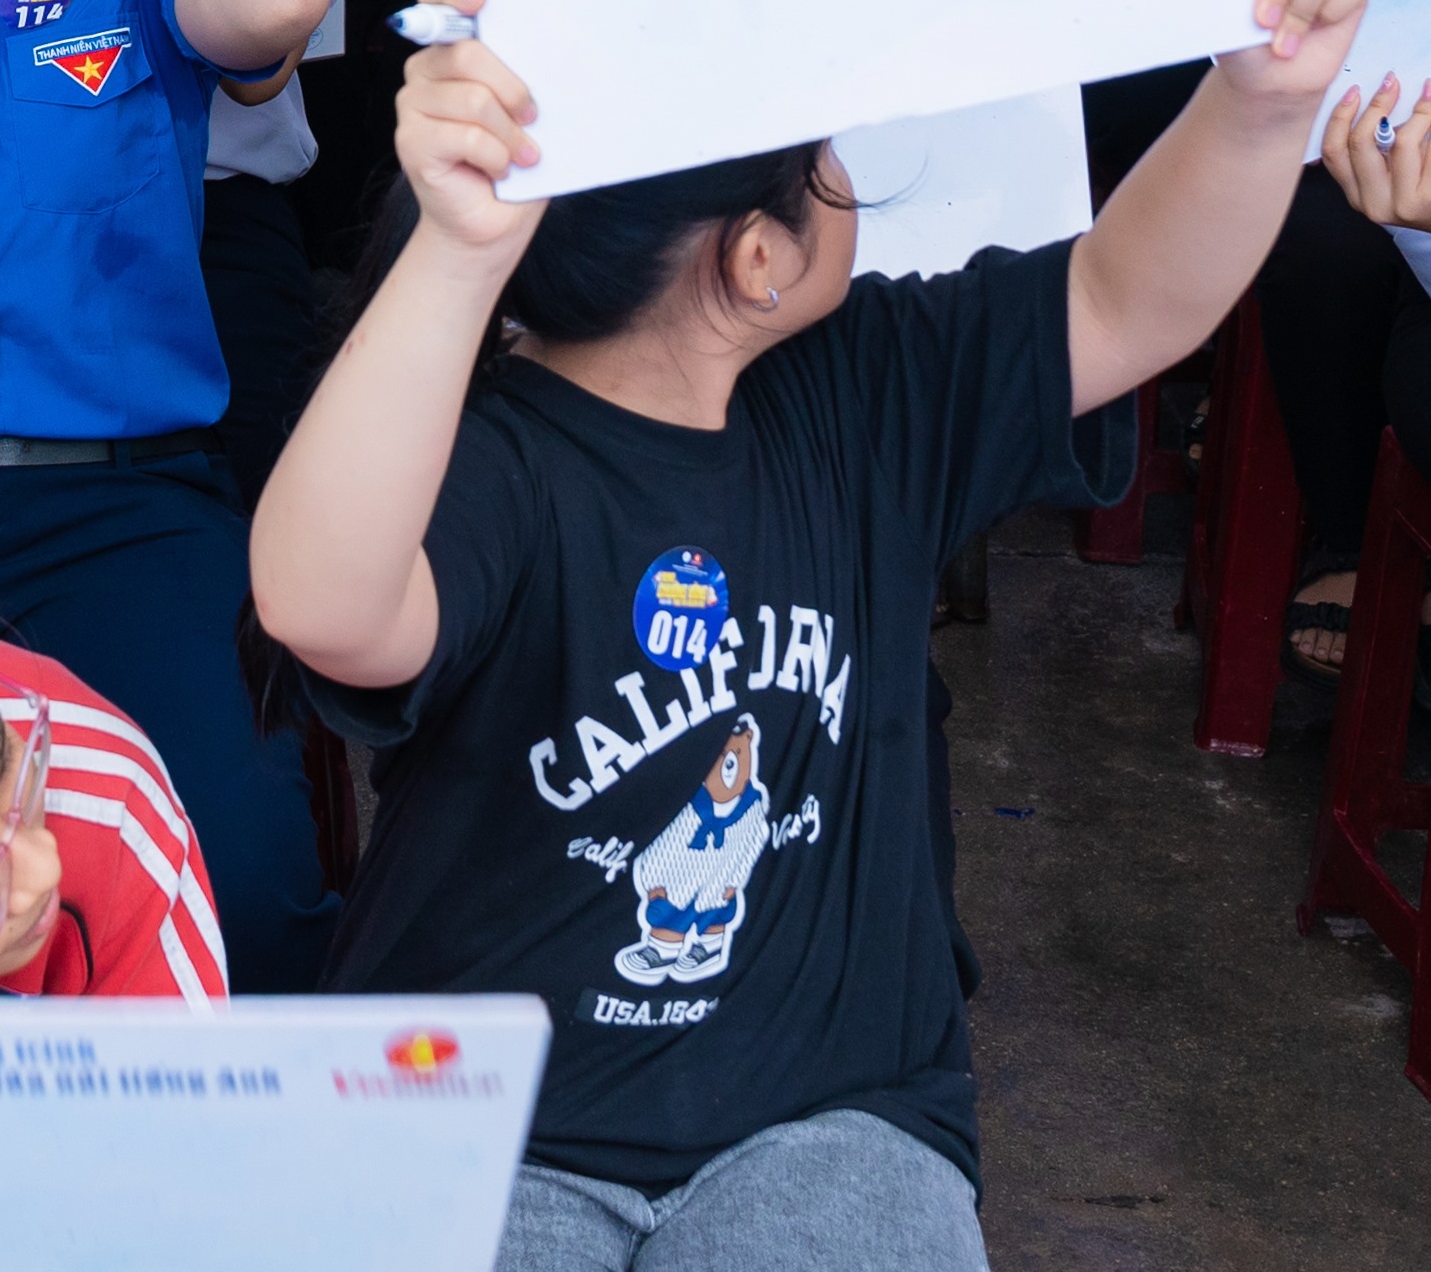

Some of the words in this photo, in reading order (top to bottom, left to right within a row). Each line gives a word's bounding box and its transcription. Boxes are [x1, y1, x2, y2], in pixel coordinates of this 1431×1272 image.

[16, 3, 63, 28] 114
[37, 46, 70, 60] THANH
[647, 609, 708, 664] 014
